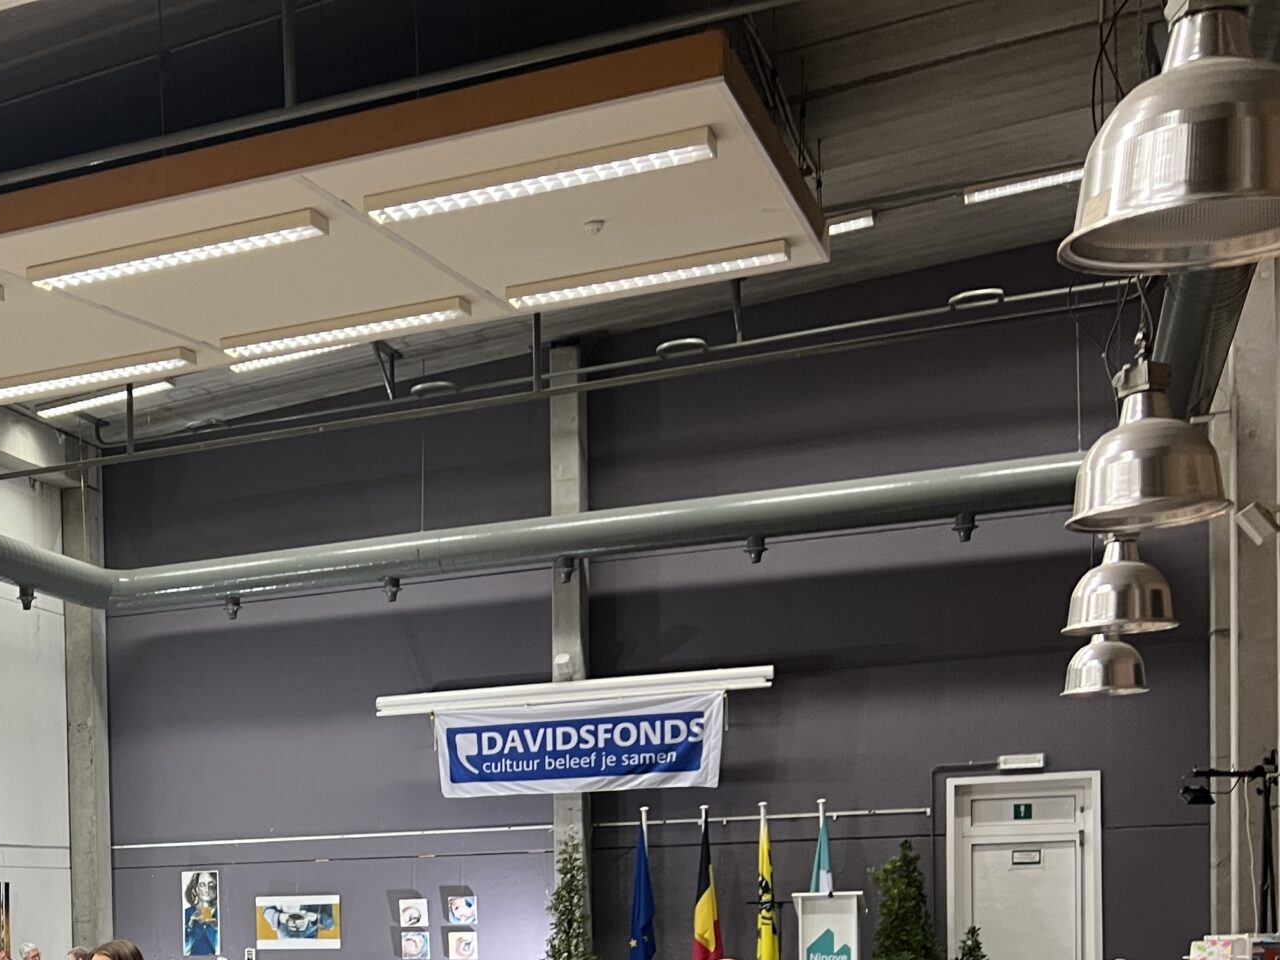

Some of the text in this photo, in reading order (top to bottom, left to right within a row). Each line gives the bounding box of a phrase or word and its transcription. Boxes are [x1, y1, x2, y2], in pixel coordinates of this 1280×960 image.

[480, 717, 705, 756] DAVIDSFONDS
[482, 749, 677, 775] cultuur beleef je samen
